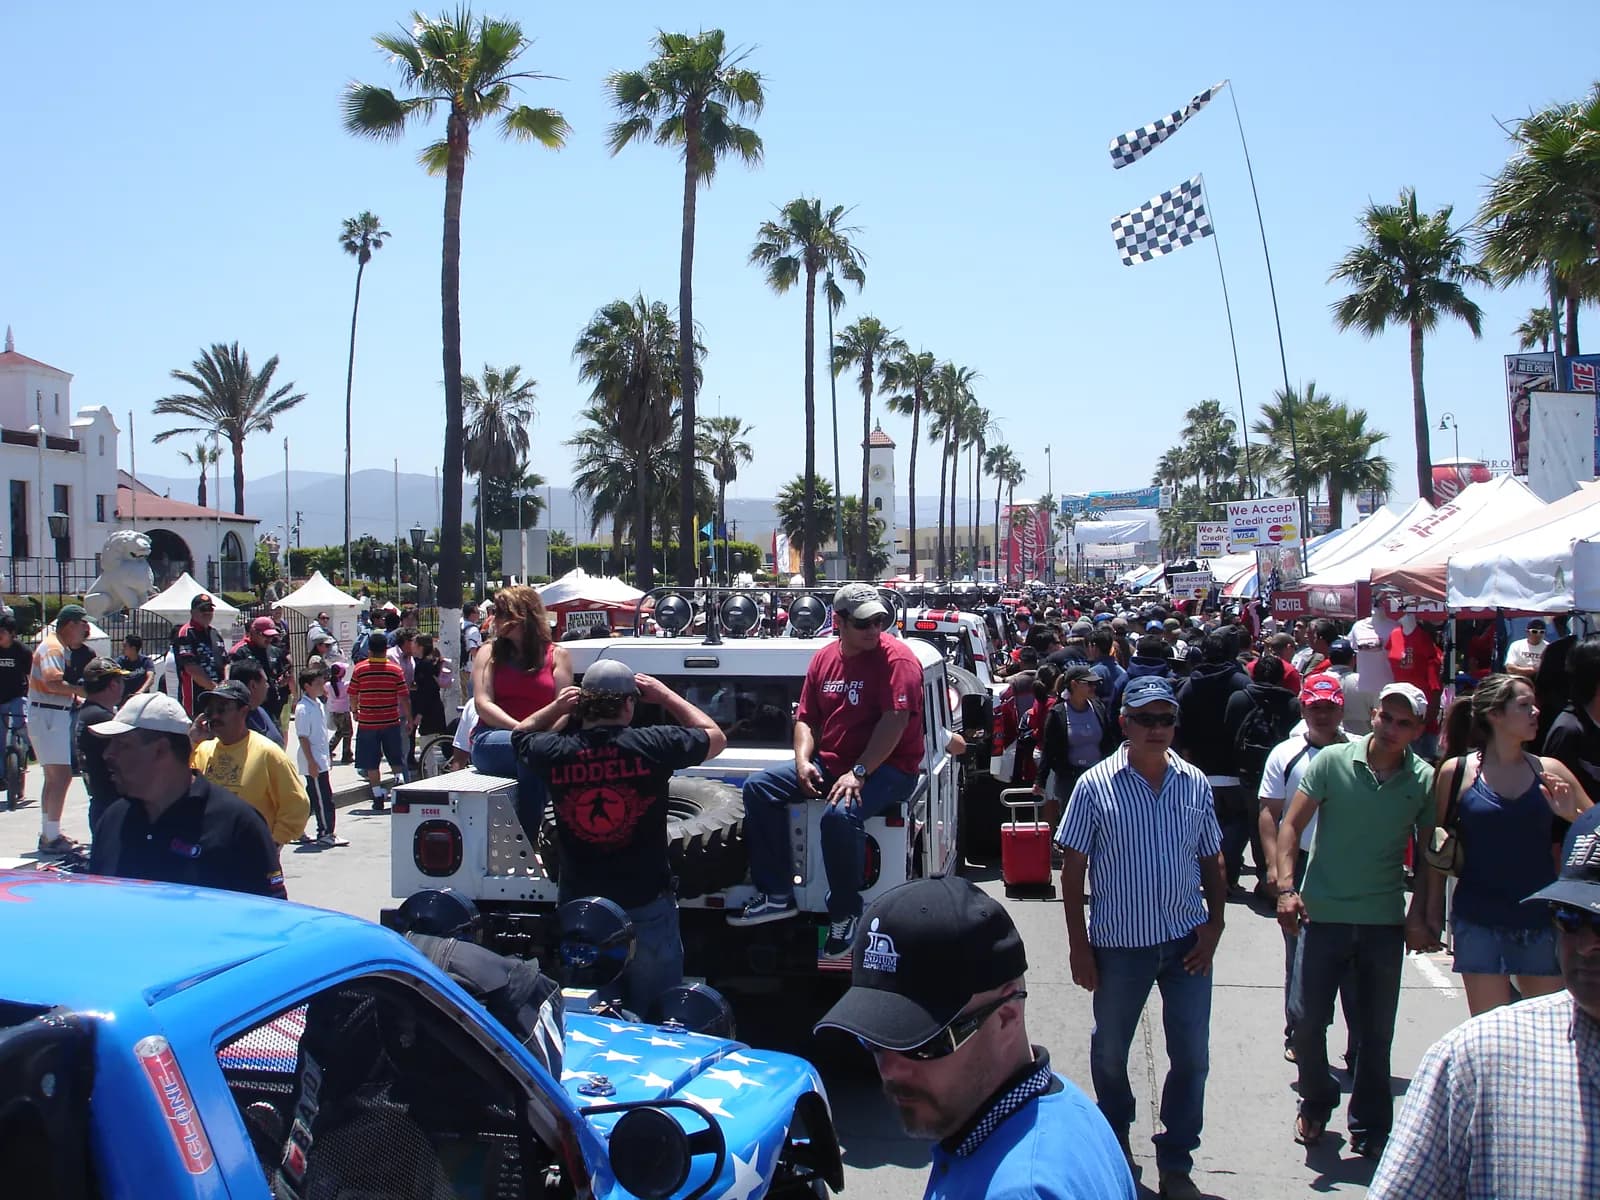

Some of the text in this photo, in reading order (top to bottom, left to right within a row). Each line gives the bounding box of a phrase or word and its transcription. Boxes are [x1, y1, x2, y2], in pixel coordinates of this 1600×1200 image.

[1527, 363, 1534, 371] EL
[1229, 502, 1296, 516] We Accept
[1234, 514, 1293, 526] Credit cards
[1199, 526, 1213, 534] We
[1275, 599, 1304, 611] NEXTEL
[0, 659, 15, 667] ANS
[576, 746, 618, 760] TEAM
[551, 757, 651, 784] LIDDELL
[864, 952, 897, 967] INDIUM
[158, 1071, 203, 1161] CLONE
